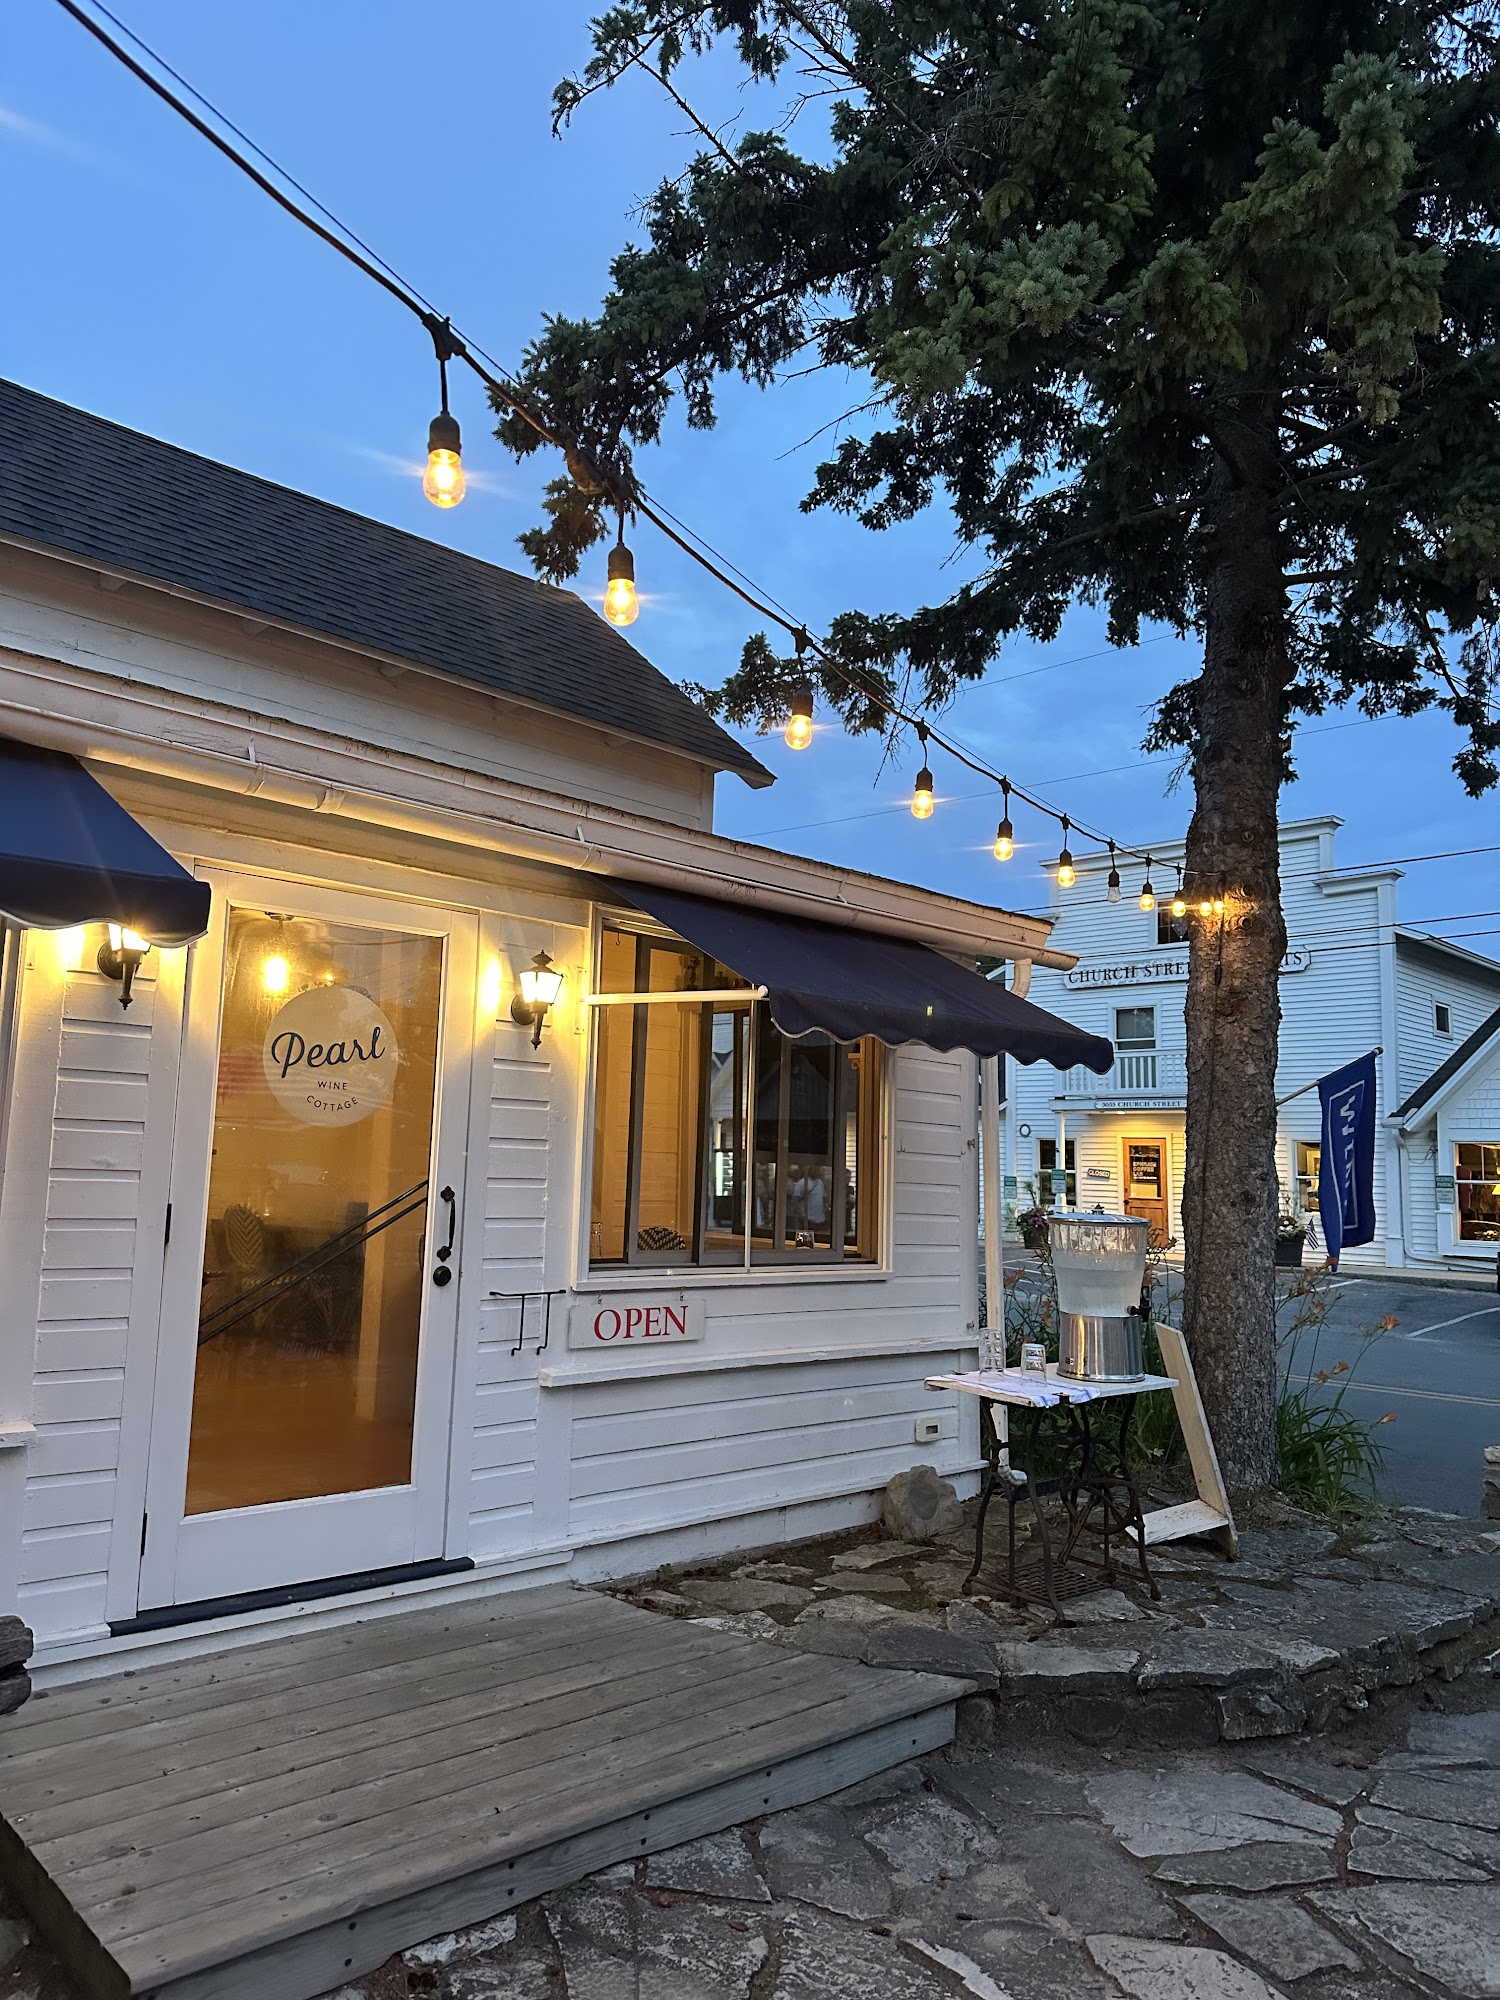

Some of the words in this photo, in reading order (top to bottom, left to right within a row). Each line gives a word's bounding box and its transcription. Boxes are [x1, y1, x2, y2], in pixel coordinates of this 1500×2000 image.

[1068, 965, 1136, 984] CHURCH
[271, 1026, 386, 1079] Pearl
[317, 1080, 348, 1091] WINE
[306, 1095, 359, 1112] COTTAGE
[1088, 1169, 1110, 1178] CLOSED
[593, 1305, 689, 1341] OPEN
